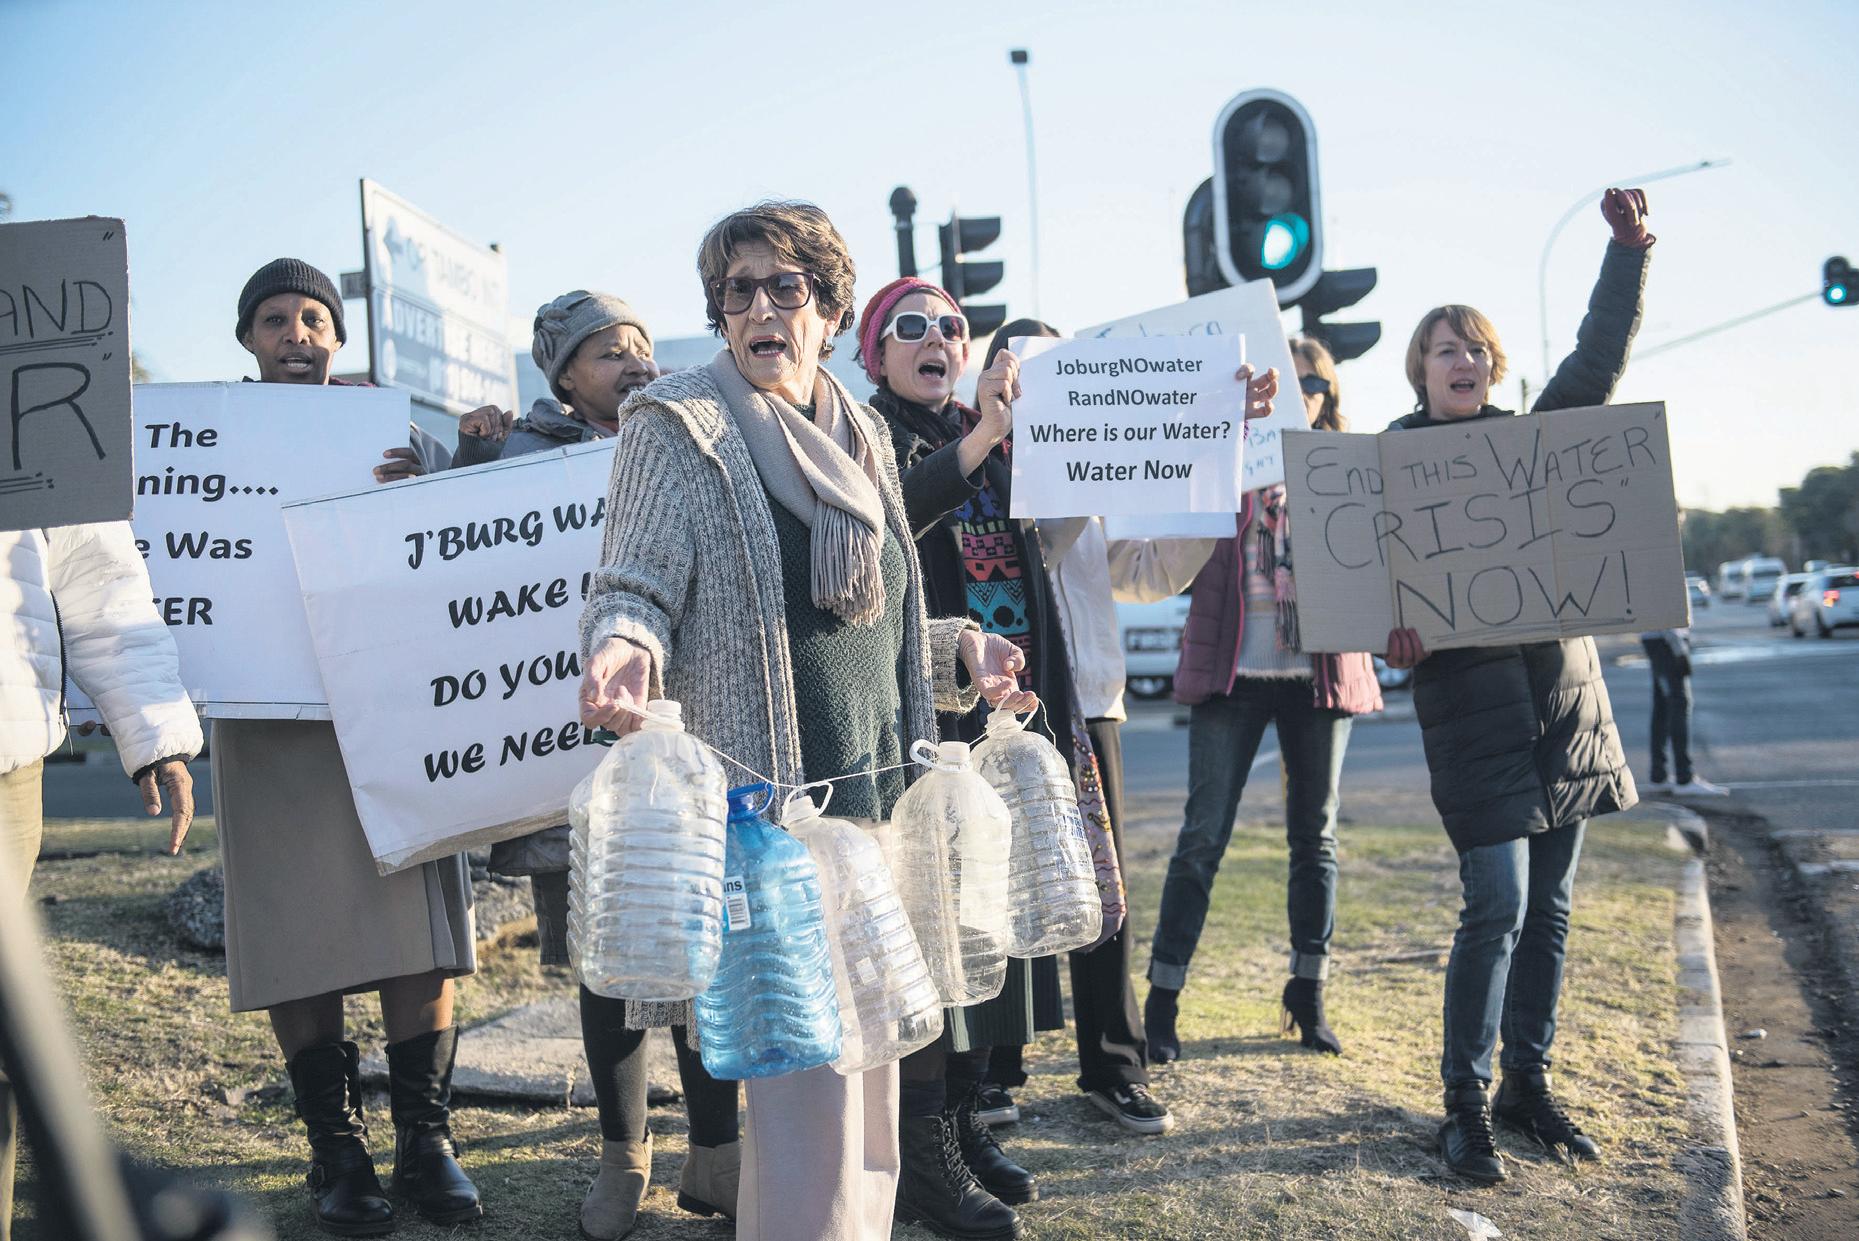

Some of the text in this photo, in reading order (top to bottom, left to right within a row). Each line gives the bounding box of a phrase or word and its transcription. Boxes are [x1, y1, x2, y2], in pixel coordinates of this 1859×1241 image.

[1056, 357, 1203, 378] JoburgNOwater
[1068, 389, 1197, 407] RandNOwater
[145, 421, 218, 449] The
[1030, 424, 1097, 443] Where
[1104, 423, 1118, 441] is
[1123, 427, 1157, 441] our
[1163, 421, 1231, 440] Water?
[1066, 459, 1193, 482] Water Now
[1400, 454, 1477, 489] THIS
[166, 531, 253, 560] Was
[405, 510, 544, 570] J'BURG
[448, 577, 569, 629] WAKE
[1397, 550, 1633, 630] NOW!
[430, 668, 487, 707] DO
[424, 742, 486, 783] WE
